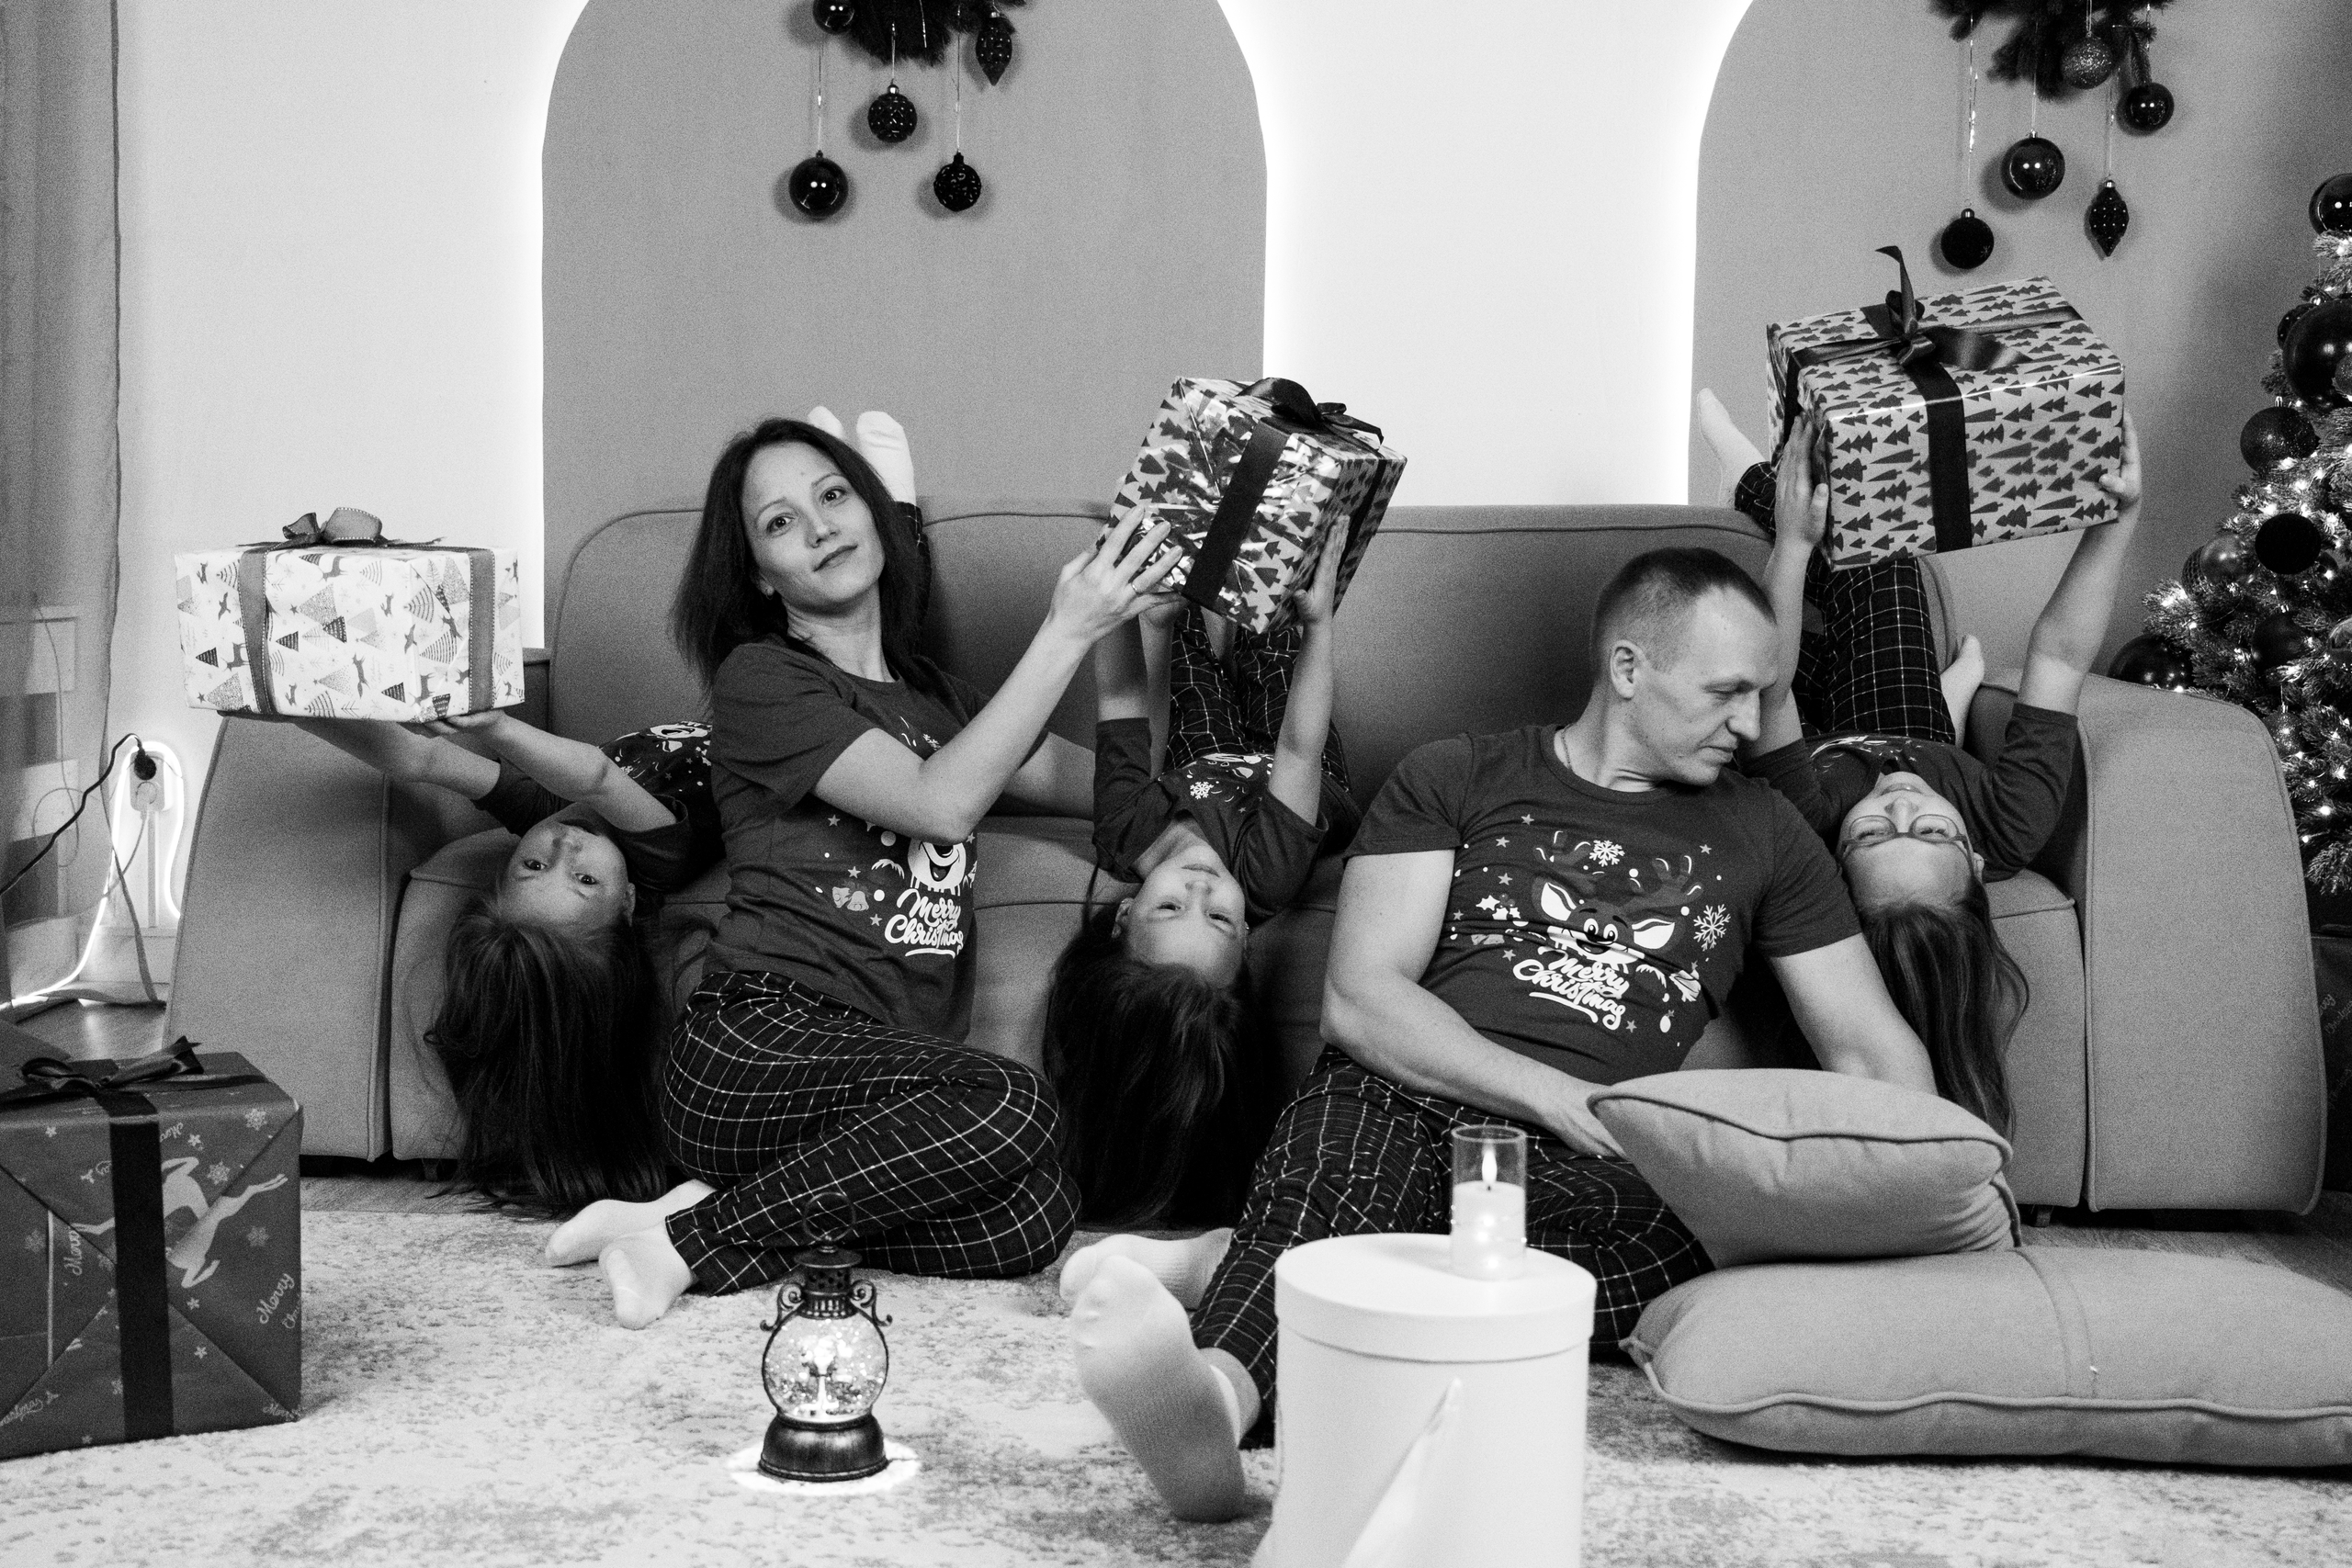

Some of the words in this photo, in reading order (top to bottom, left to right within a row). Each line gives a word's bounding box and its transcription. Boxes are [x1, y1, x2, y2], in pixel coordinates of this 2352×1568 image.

[885, 913, 965, 956] Christmas
[896, 887, 961, 930] Merry
[1512, 958, 1626, 1031] Christmas
[1537, 945, 1630, 999] Merry
[255, 1272, 296, 1325] Merry
